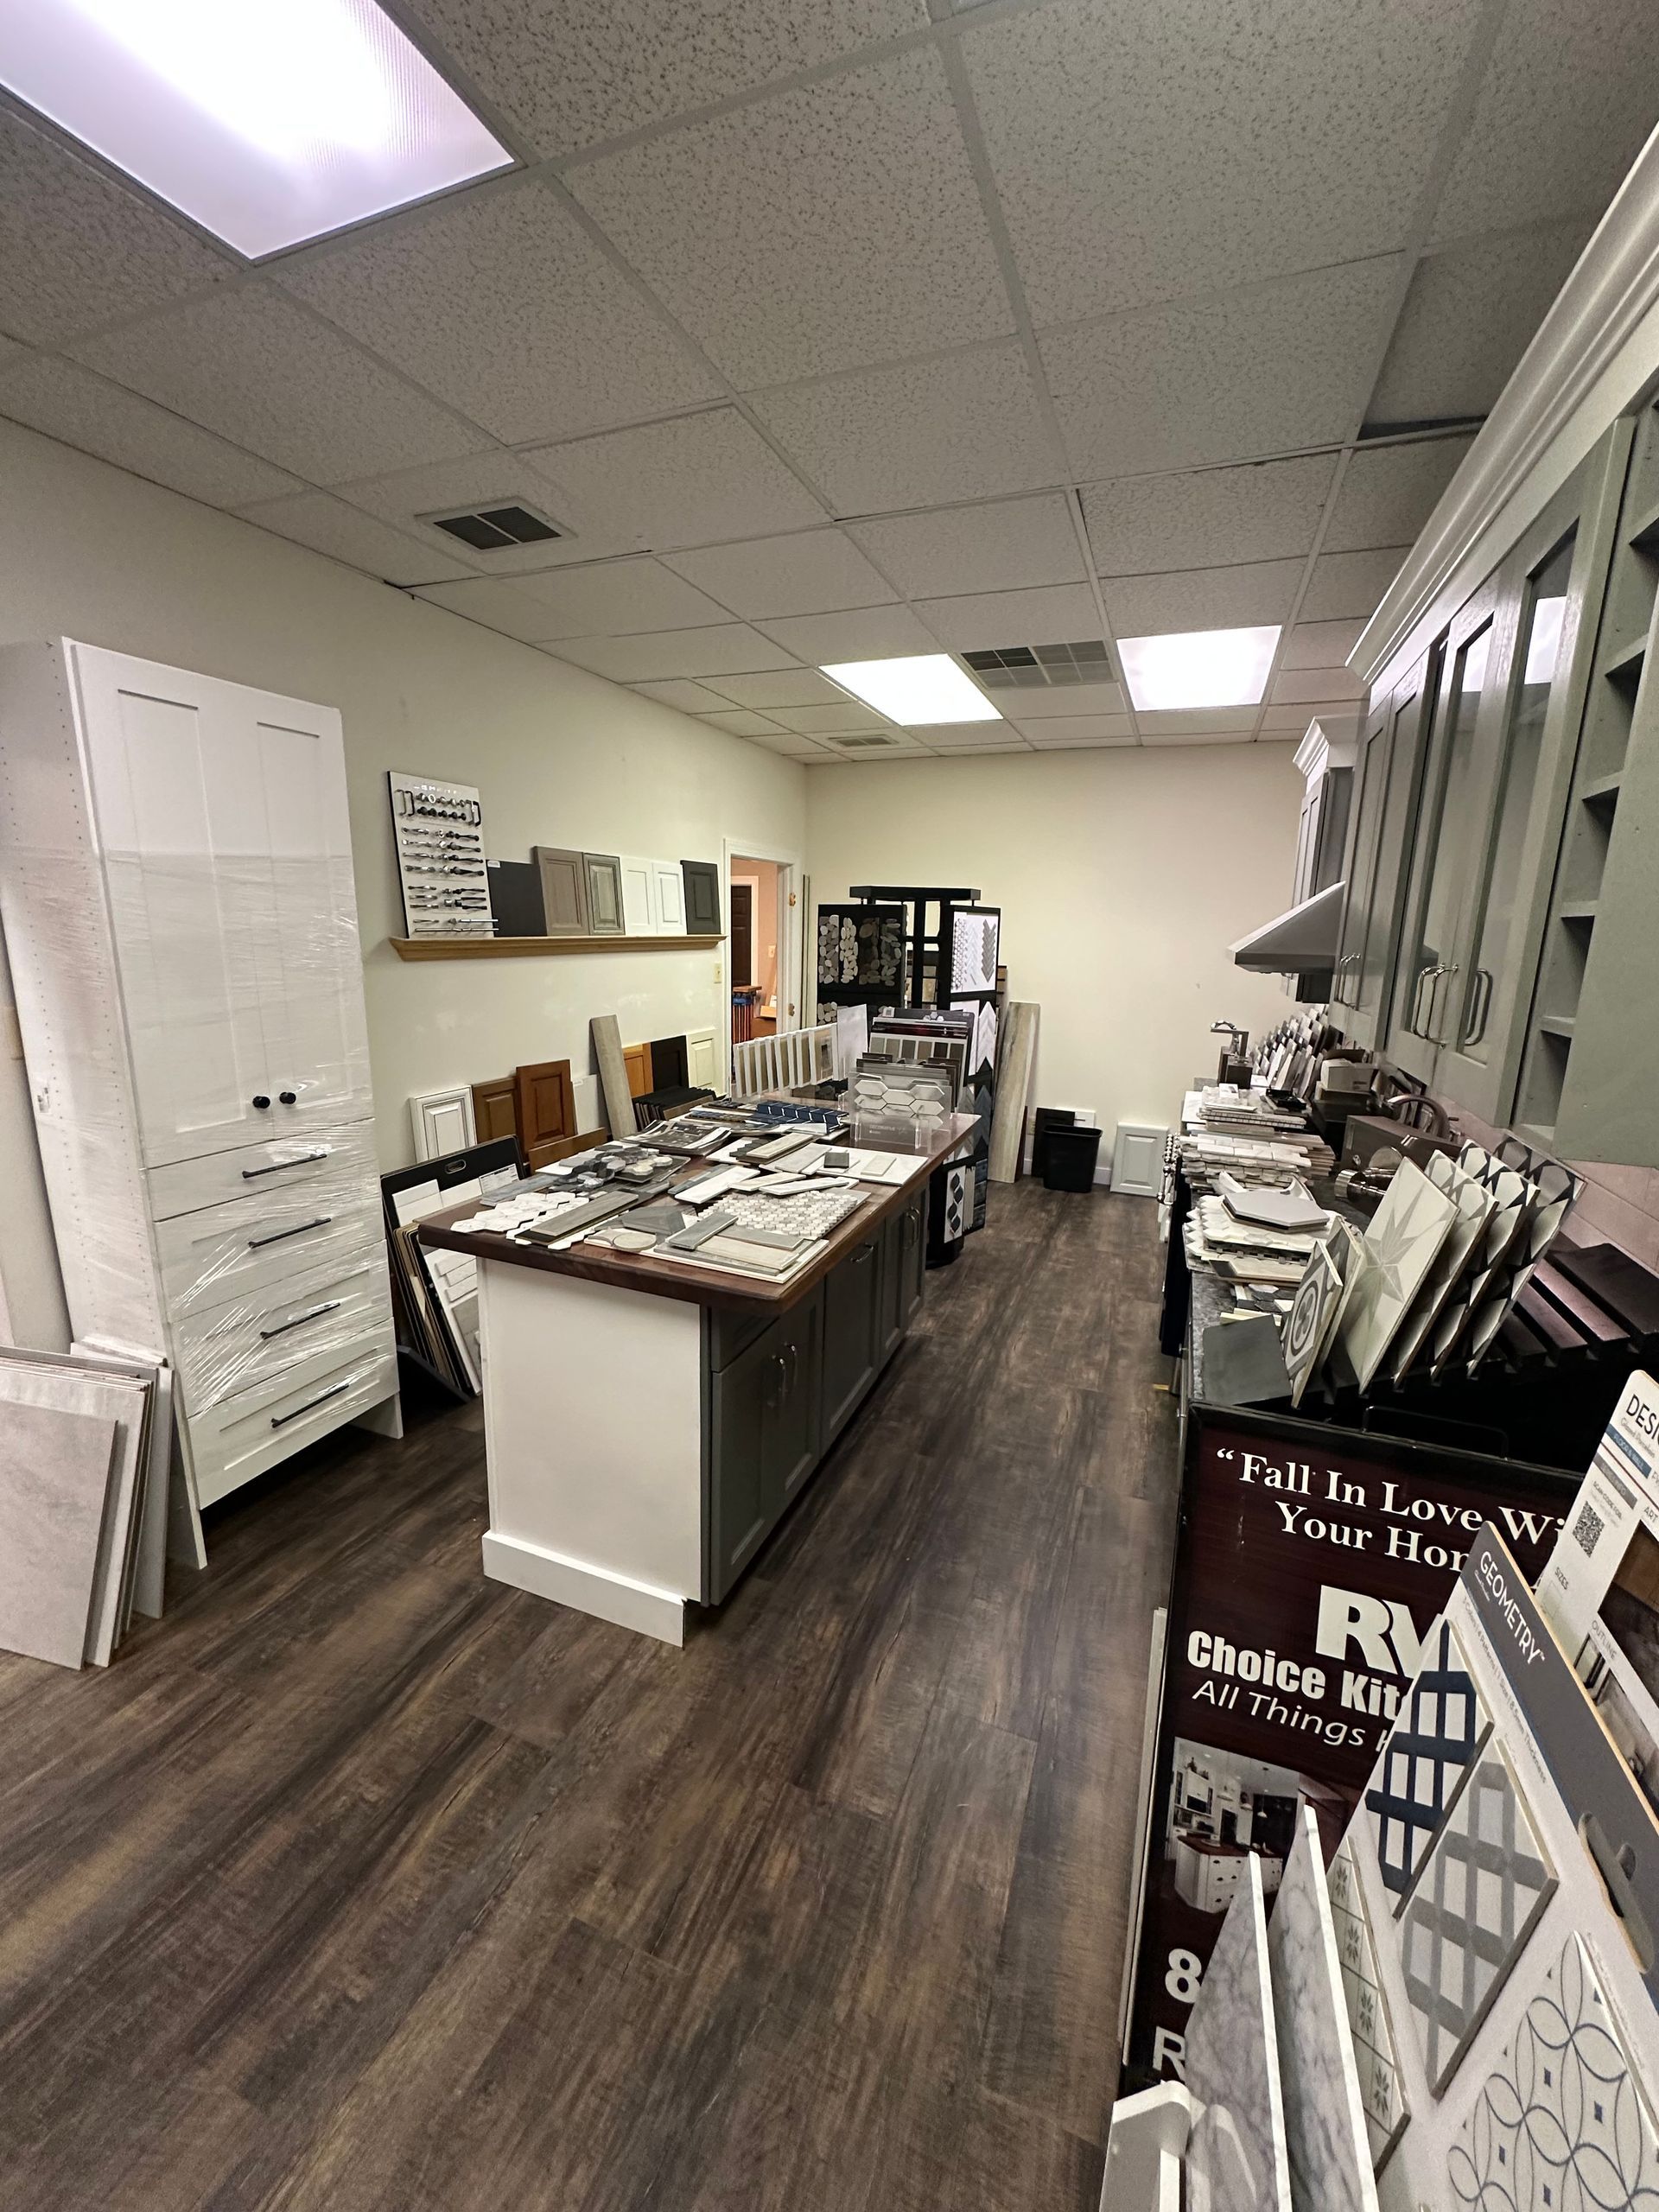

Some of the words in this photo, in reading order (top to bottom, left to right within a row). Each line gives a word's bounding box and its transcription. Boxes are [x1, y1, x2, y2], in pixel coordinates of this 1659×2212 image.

[1626, 1393, 1659, 1445] DESI
[1275, 1501, 1373, 1551] Your
[1325, 1470, 1366, 1508] In
[1379, 1481, 1483, 1531] Love
[1554, 1567, 1569, 1591] SIZES
[1592, 1620, 1617, 1661] OUTLINE
[1187, 1630, 1325, 1700] Choice
[1341, 1669, 1407, 1721] Kit
[1192, 1680, 1240, 1709] All
[1249, 1690, 1366, 1745] Things
[1165, 1948, 1202, 2004] 8
